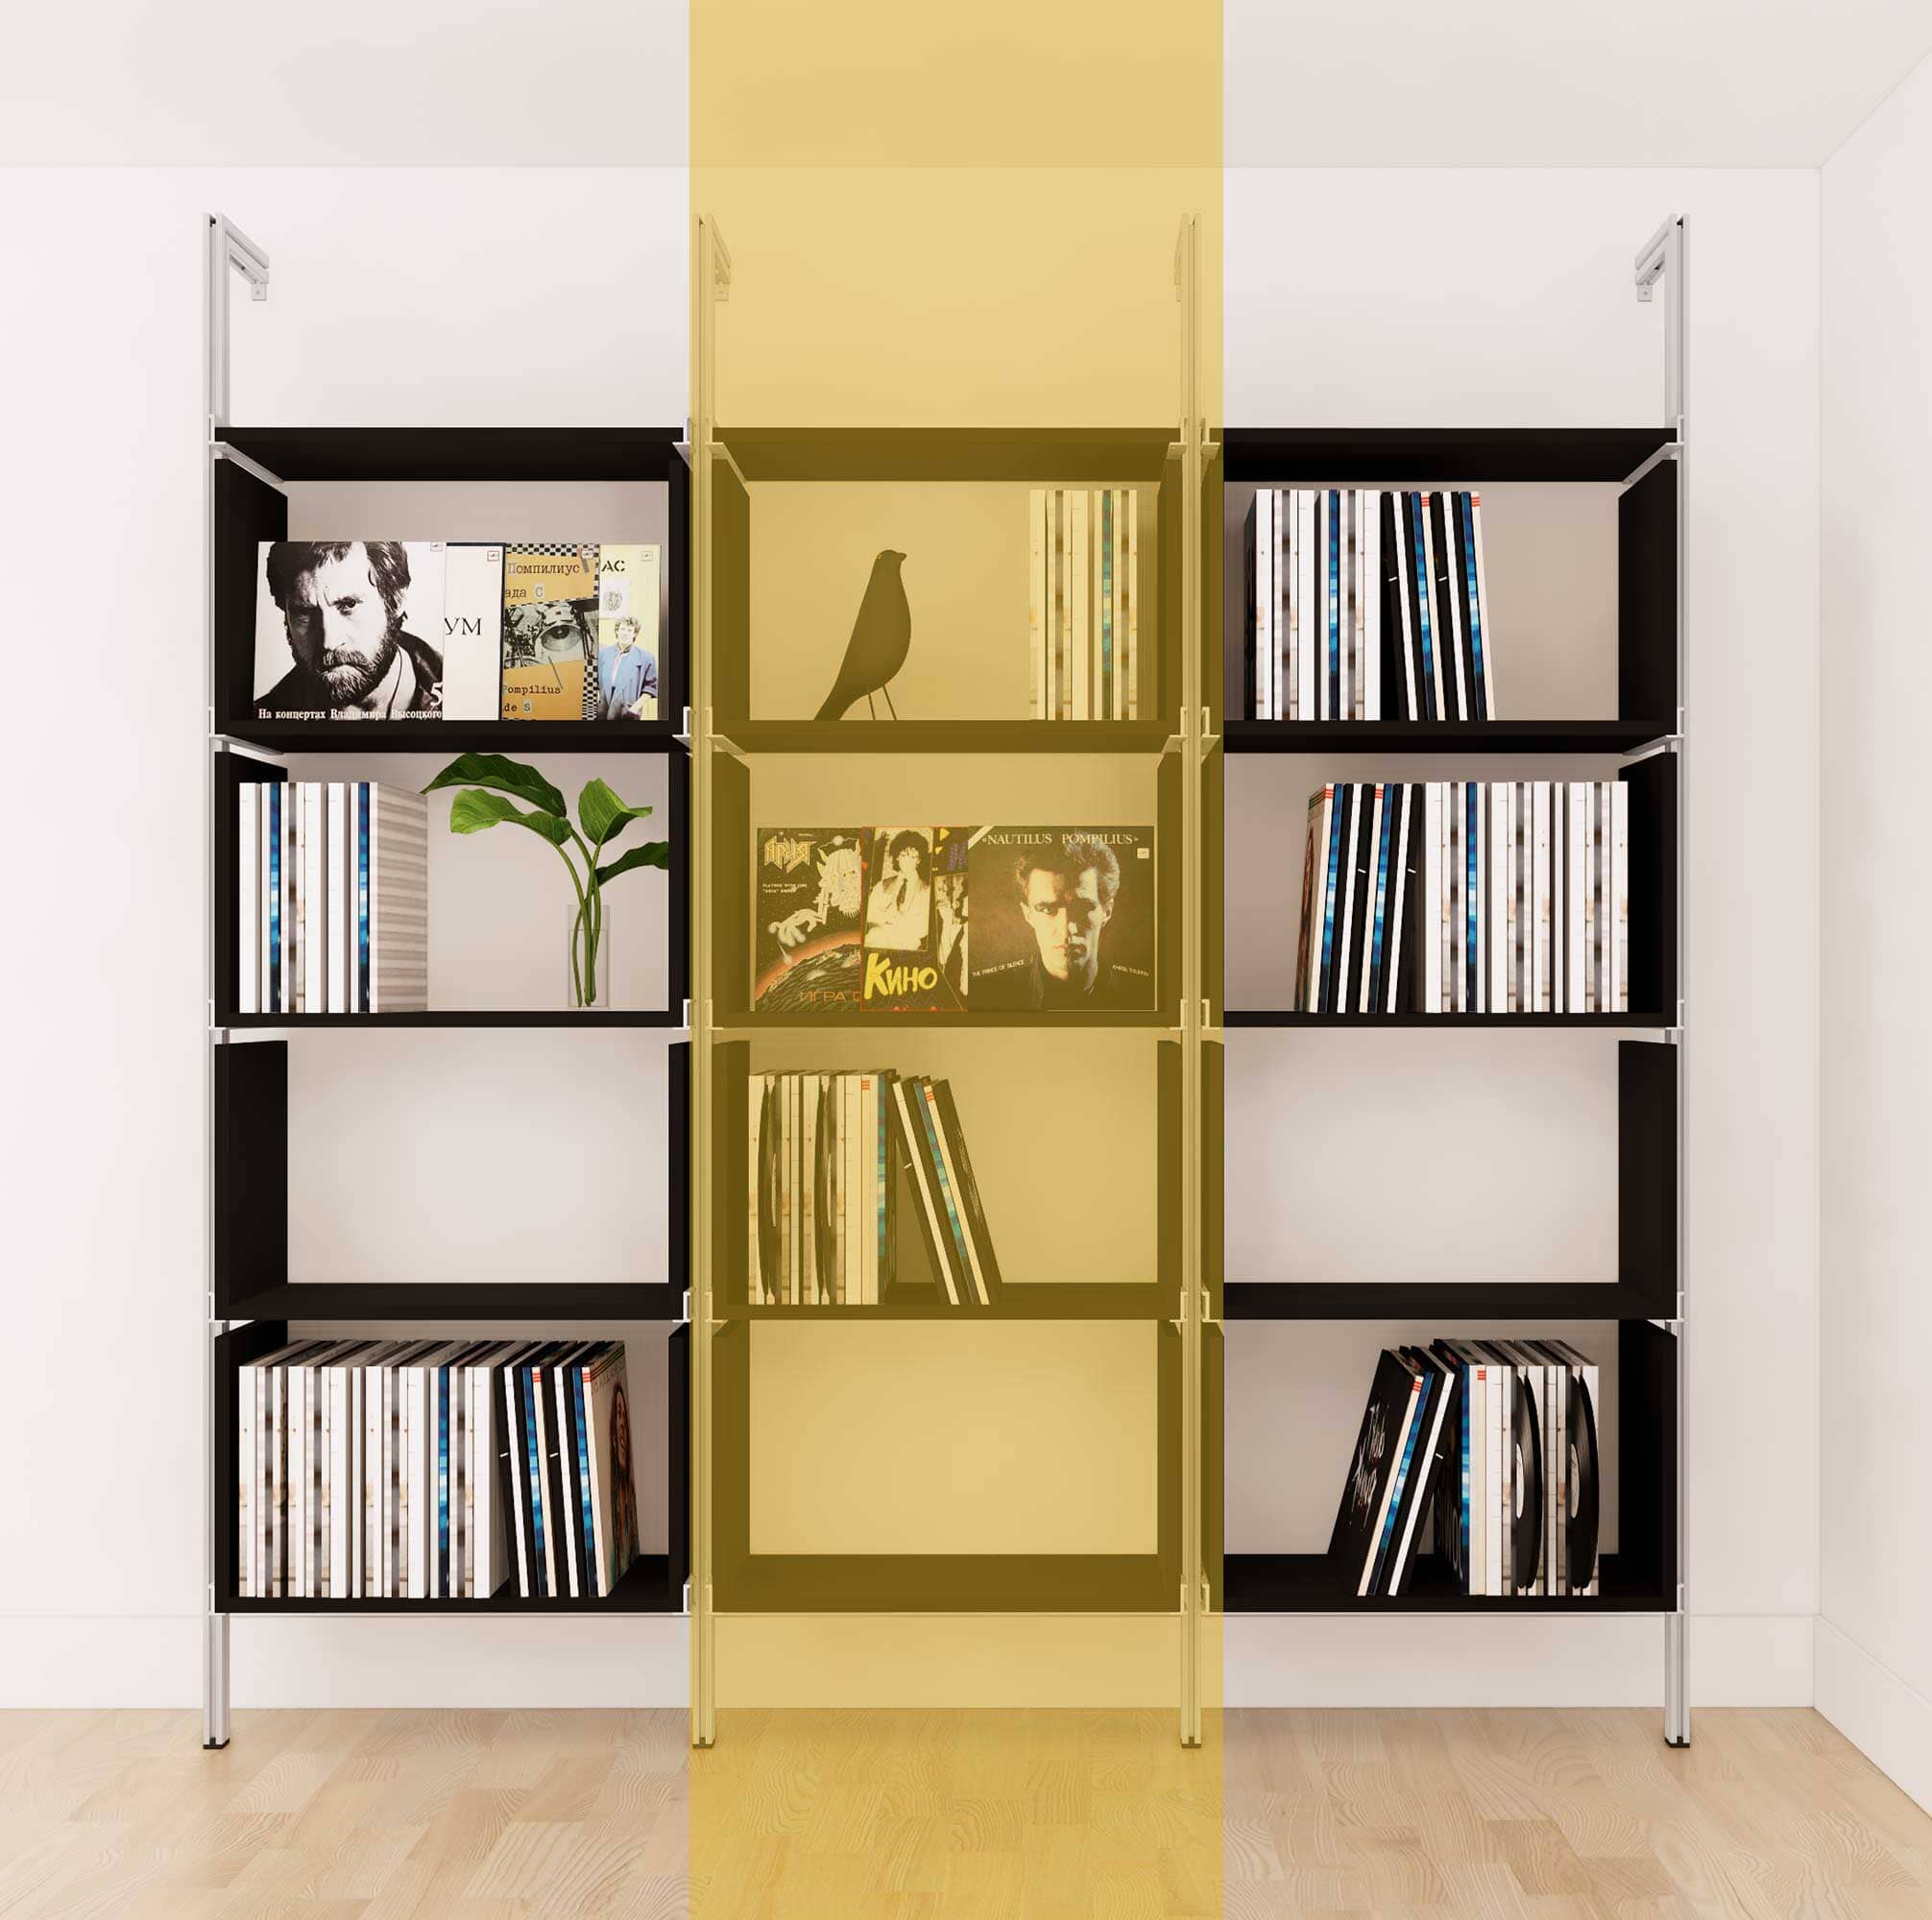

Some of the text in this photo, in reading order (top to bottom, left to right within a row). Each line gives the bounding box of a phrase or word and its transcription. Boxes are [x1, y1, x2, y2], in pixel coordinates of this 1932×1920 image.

[507, 563, 580, 576] Помпилиус
[429, 683, 443, 707] 5
[258, 708, 272, 719] На
[276, 709, 326, 720] концертах
